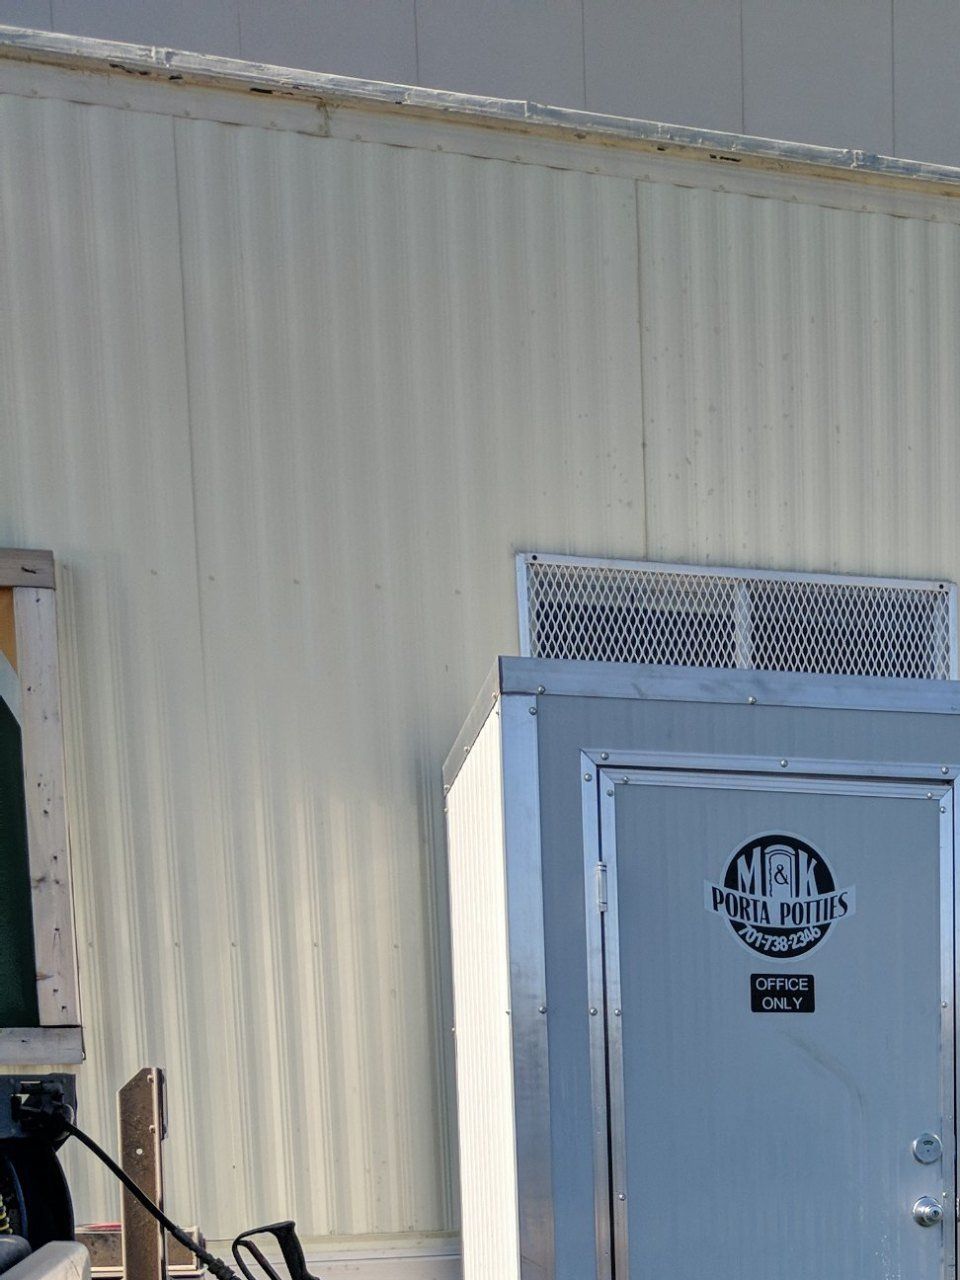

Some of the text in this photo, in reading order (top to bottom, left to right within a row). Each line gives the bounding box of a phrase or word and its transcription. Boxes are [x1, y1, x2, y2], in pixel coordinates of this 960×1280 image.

[712, 886, 849, 926] PORTA POTTIES
[738, 925, 822, 952] 701-738-2346
[755, 977, 809, 991] OFFICE
[761, 997, 803, 1010] ONLY
